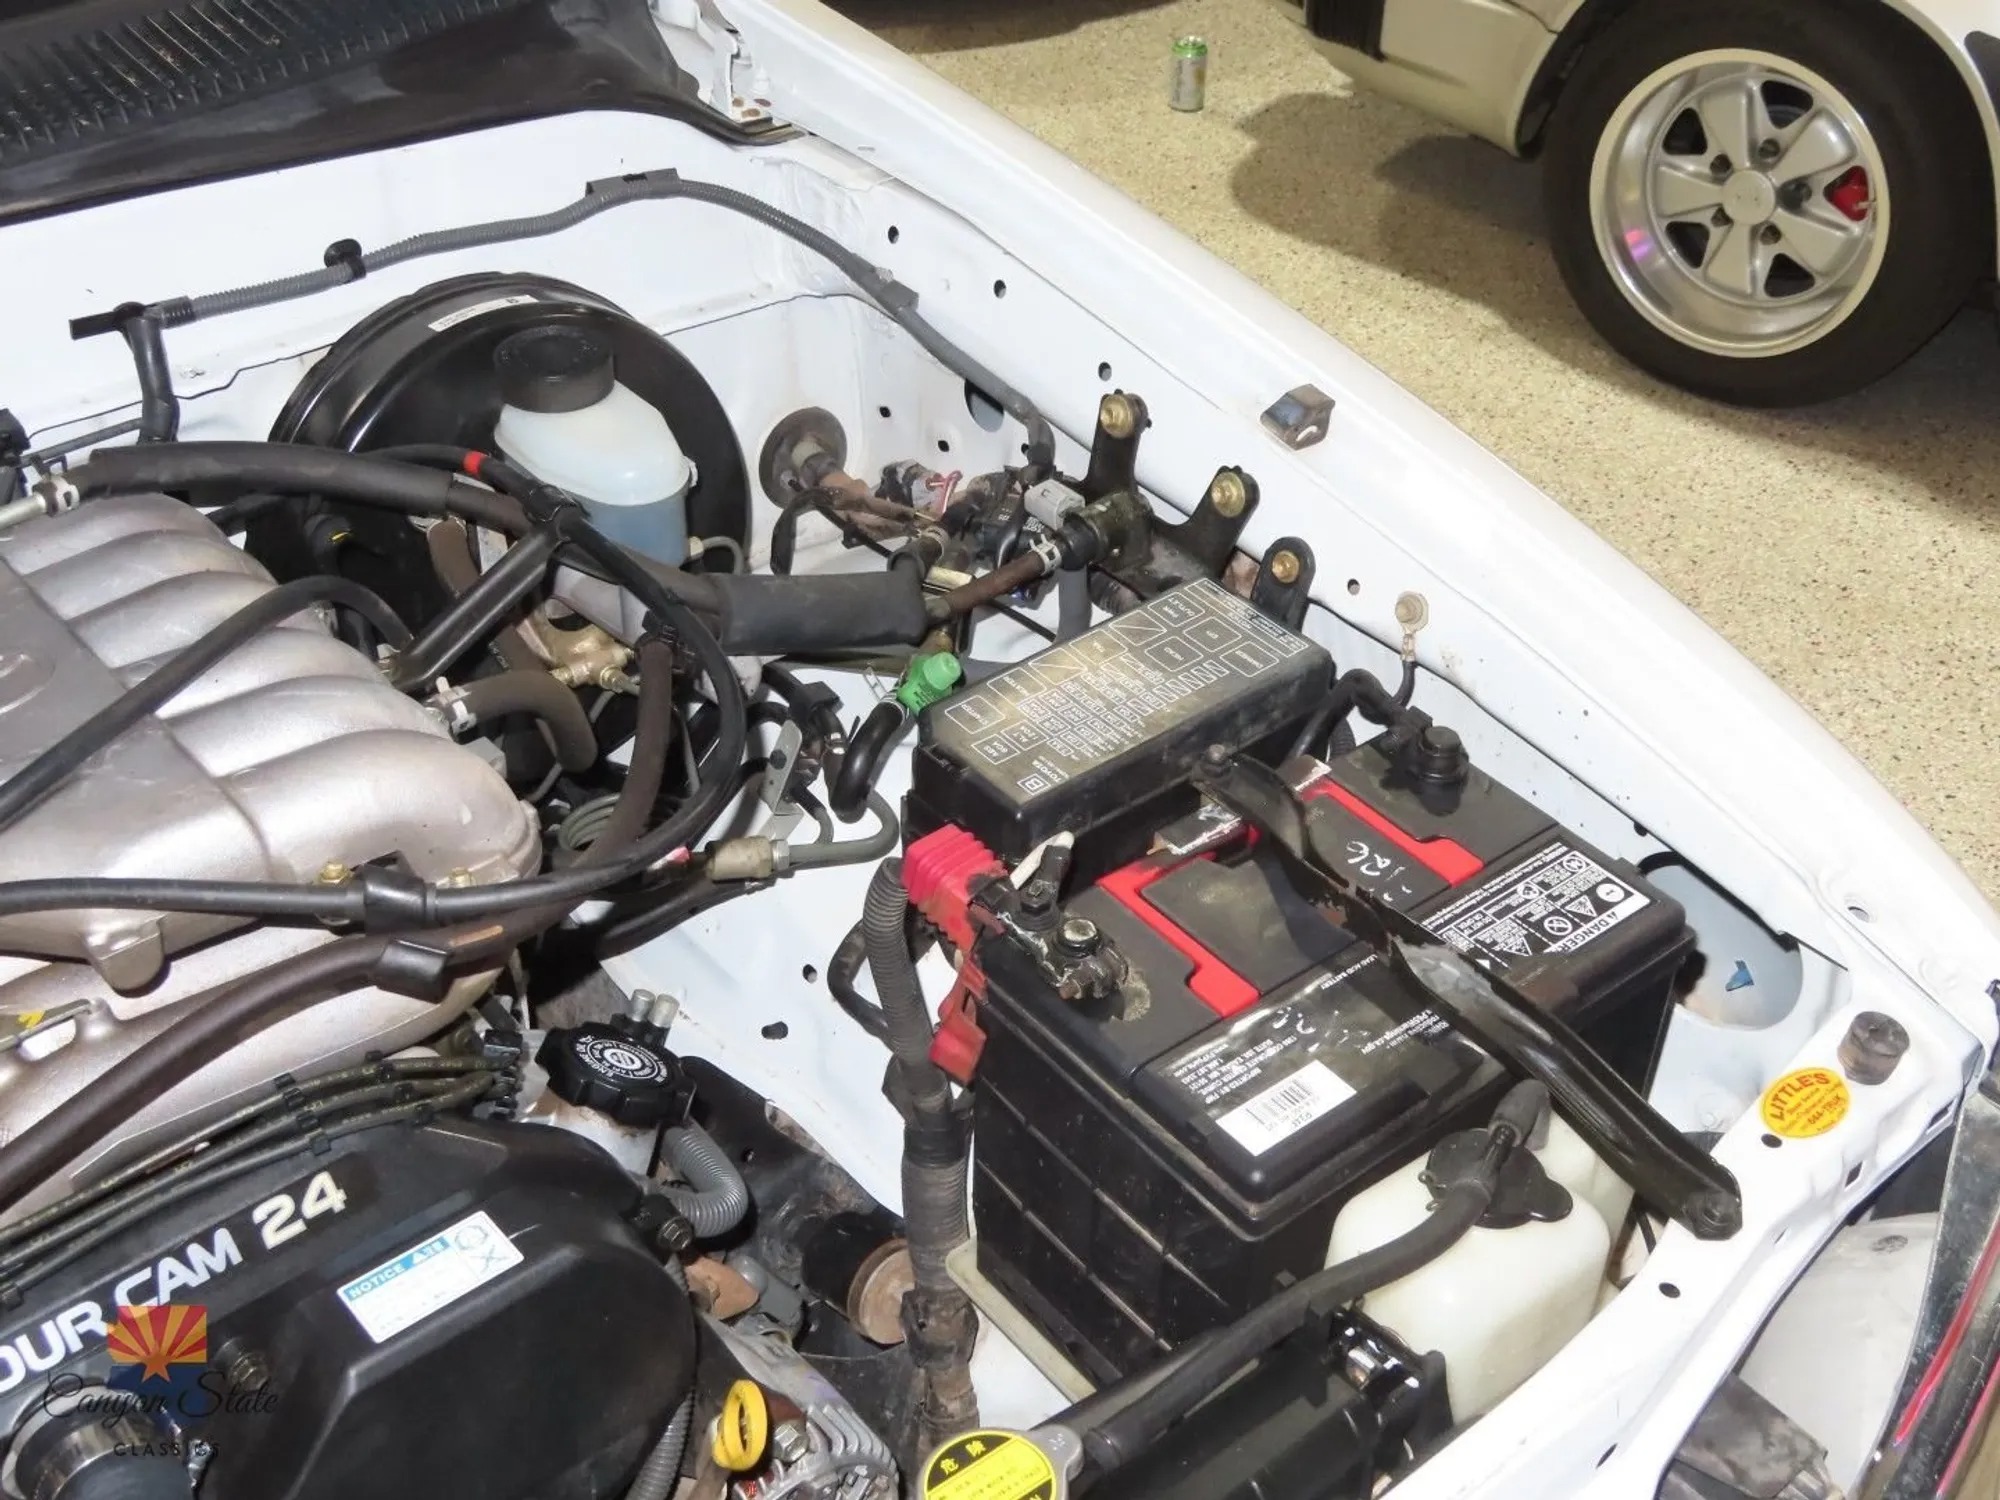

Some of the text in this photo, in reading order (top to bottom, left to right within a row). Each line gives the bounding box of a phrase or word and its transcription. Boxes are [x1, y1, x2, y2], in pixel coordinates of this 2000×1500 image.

[1023, 776, 1044, 791] B
[1030, 759, 1062, 782] TOYOTA
[1558, 917, 1610, 953] DANGER
[1320, 972, 1346, 989] BATTERY
[1769, 1072, 1829, 1120] LITTLE'S
[0, 1171, 347, 1394] OUR CAM 24
[347, 1261, 405, 1298] NOTICE
